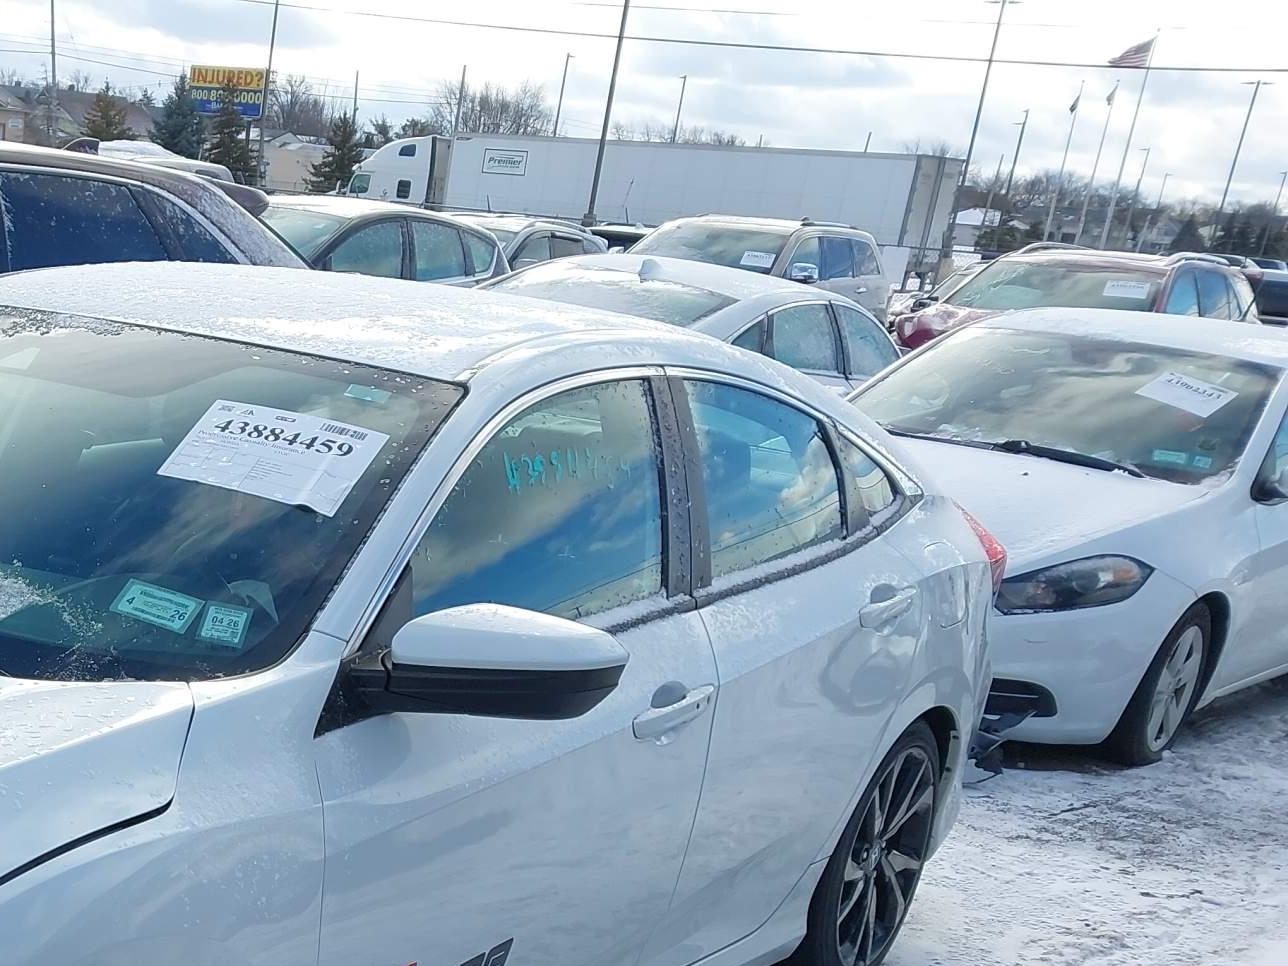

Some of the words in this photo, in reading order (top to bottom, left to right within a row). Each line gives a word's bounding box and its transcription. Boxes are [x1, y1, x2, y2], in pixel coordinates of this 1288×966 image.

[192, 68, 264, 87] INJURED?
[488, 156, 522, 166] Premier
[214, 418, 355, 457] 43884459
[126, 596, 136, 605] 4
[169, 609, 188, 621] 26
